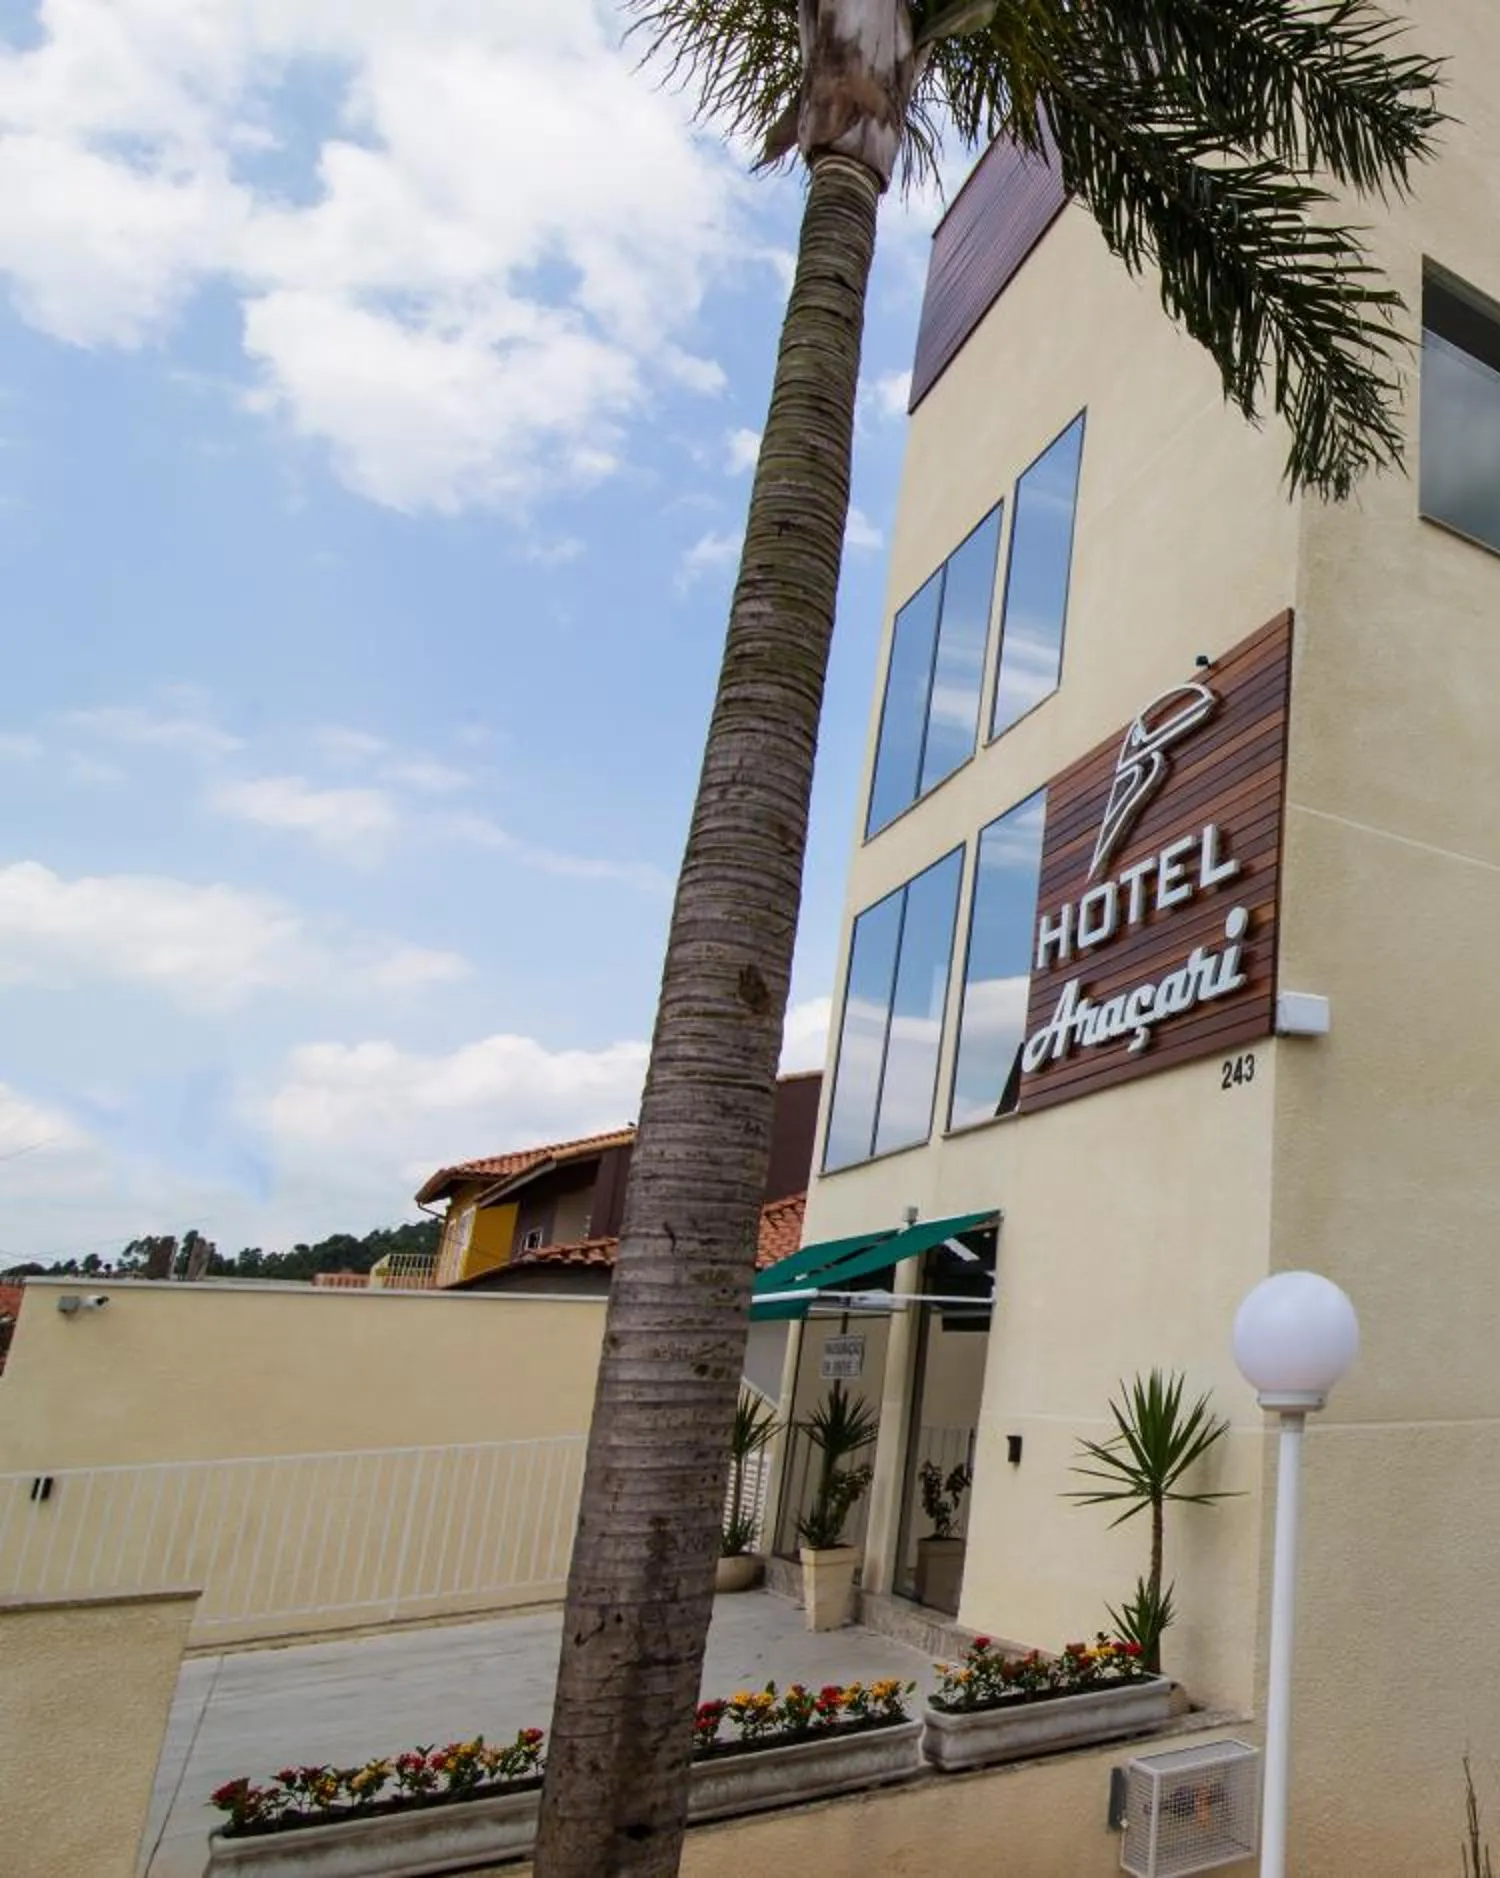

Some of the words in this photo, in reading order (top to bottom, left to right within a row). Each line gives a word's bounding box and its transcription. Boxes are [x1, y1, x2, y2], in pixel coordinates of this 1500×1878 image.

[1036, 823, 1242, 970] HOTEL
[1021, 906, 1249, 1073] Araçari
[1222, 1053, 1255, 1090] 243
